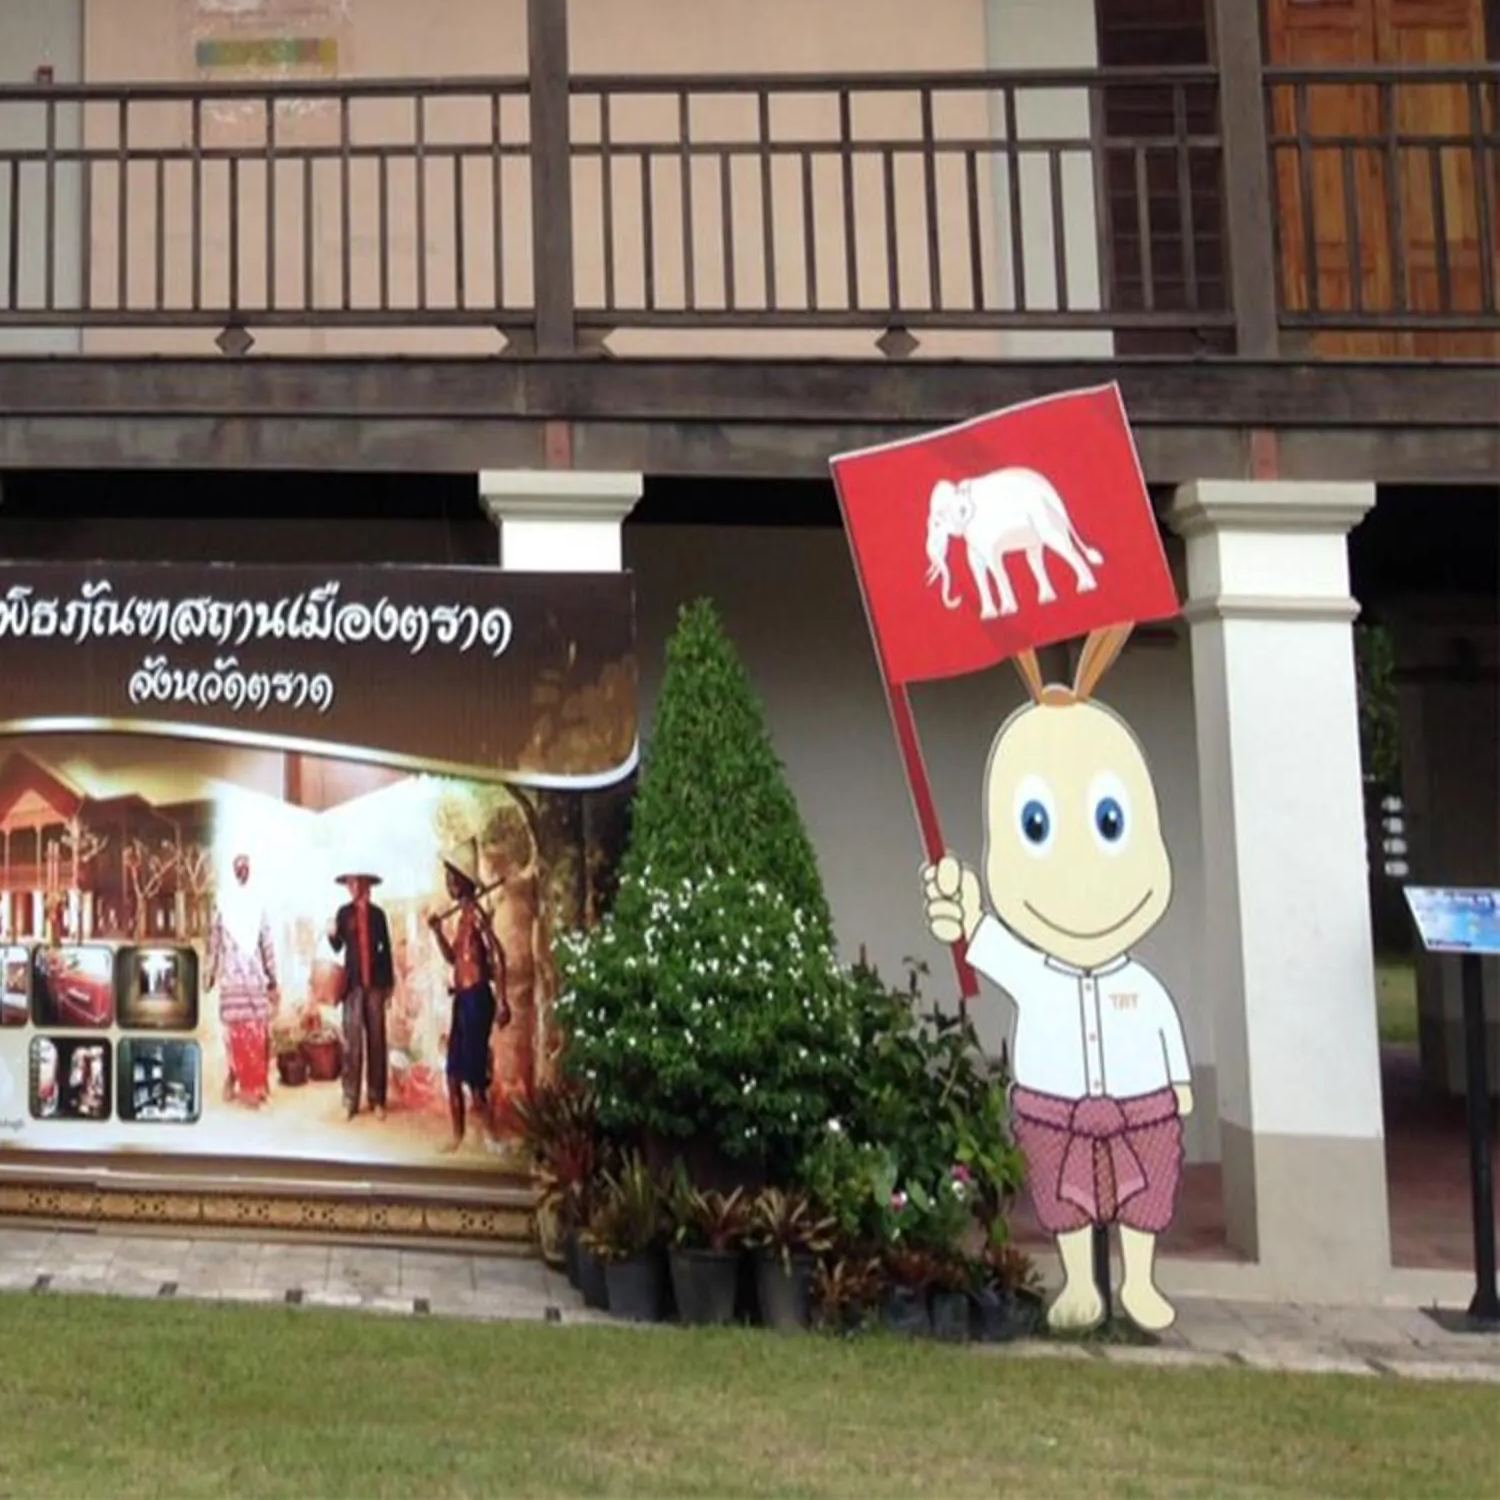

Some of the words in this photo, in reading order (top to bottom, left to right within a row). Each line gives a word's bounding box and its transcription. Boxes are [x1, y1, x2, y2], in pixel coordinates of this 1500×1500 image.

[127, 654, 334, 712] จังหวัดตราด
